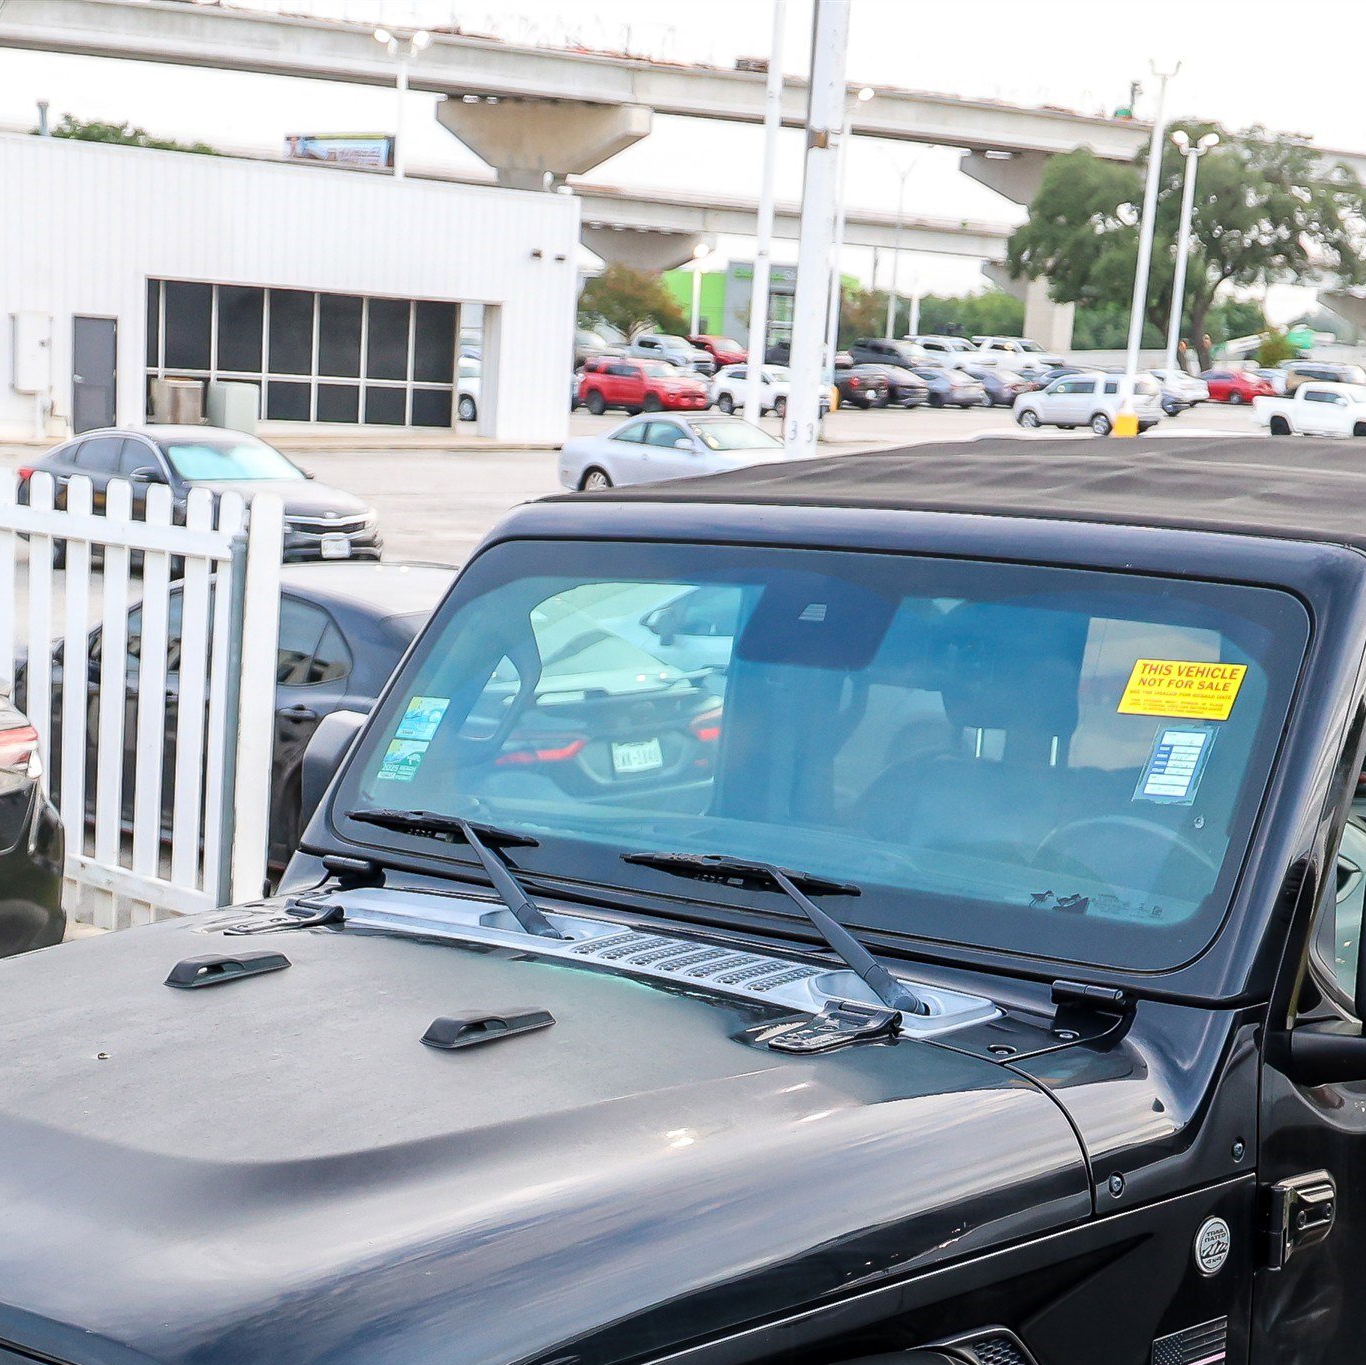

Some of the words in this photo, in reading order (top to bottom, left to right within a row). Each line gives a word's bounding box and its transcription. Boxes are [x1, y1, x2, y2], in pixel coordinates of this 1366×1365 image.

[1140, 663, 1173, 676] THIS
[1177, 664, 1240, 680] VEHICLE
[1138, 677, 1165, 688] NOT
[1167, 679, 1194, 689] FOR
[1197, 681, 1232, 692] SALE
[1204, 1232, 1227, 1243] RATED
[1206, 1228, 1225, 1238] TRAIL
